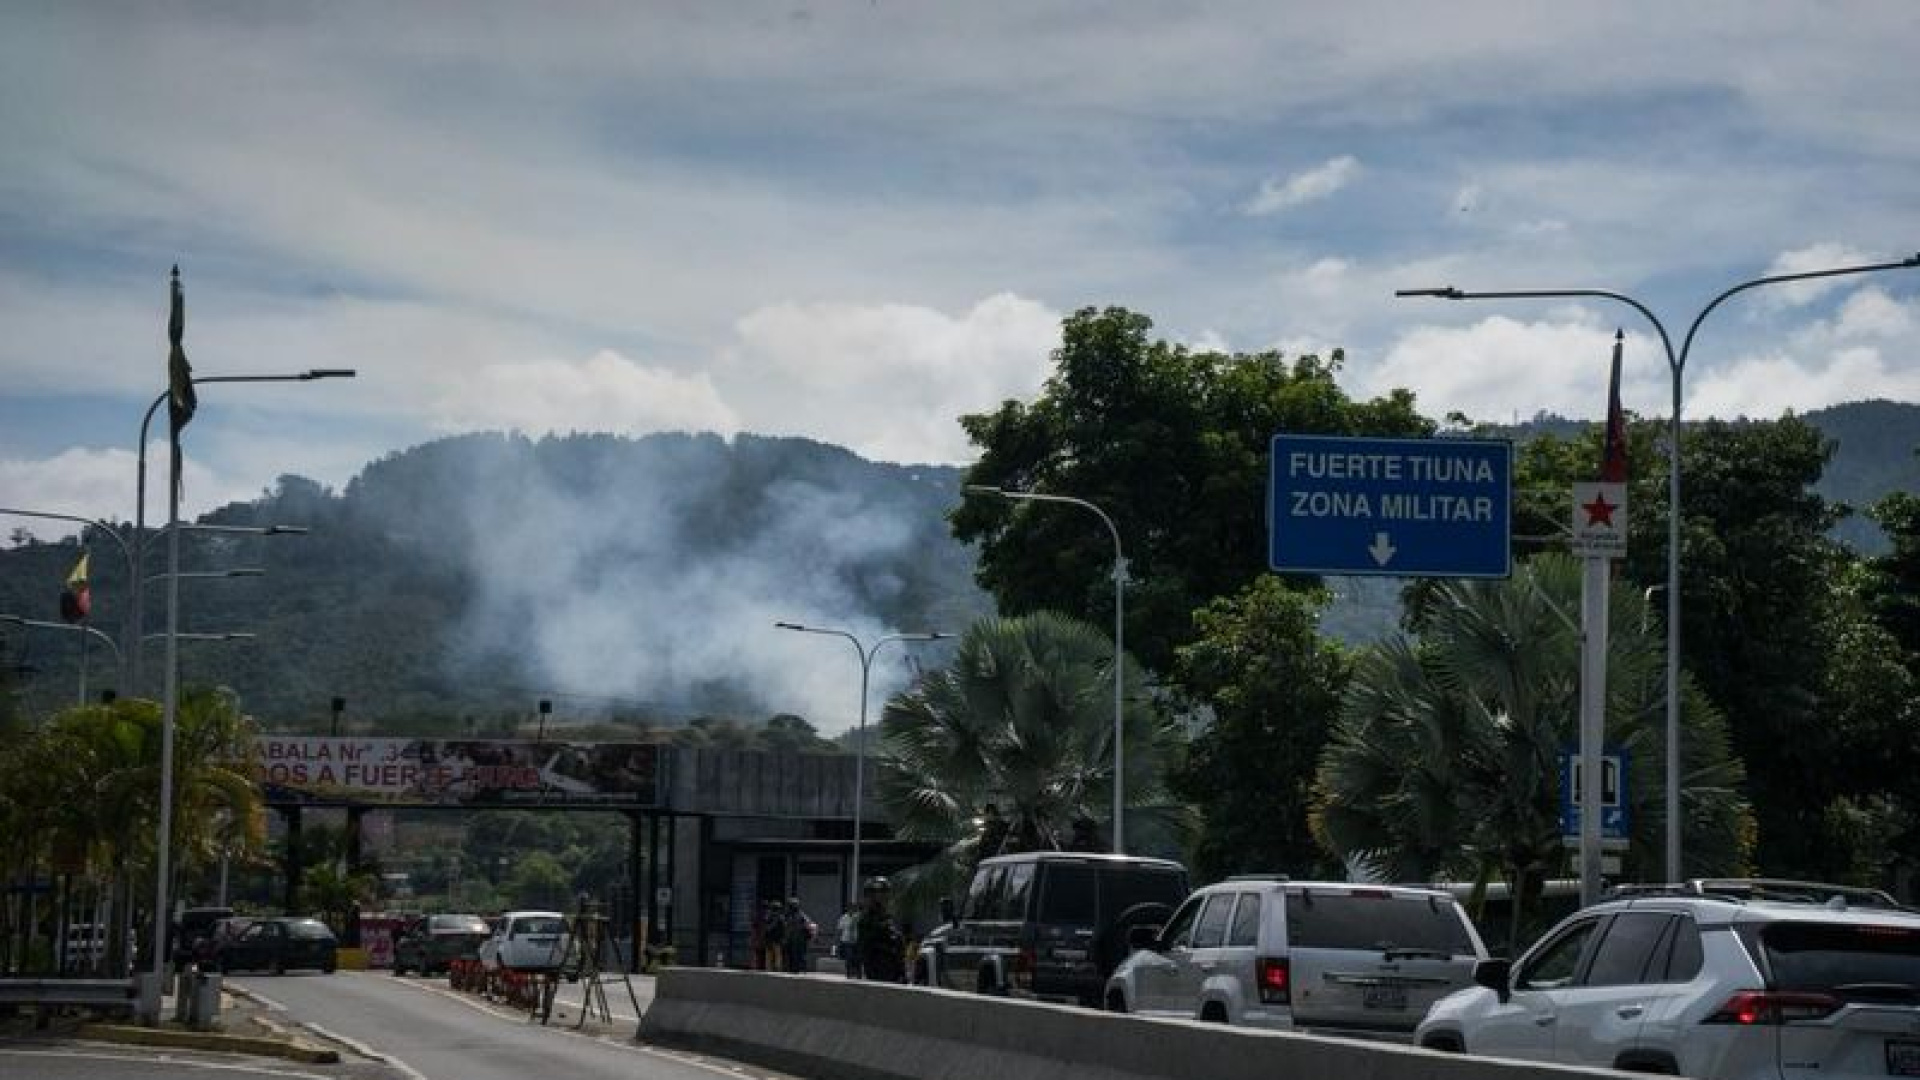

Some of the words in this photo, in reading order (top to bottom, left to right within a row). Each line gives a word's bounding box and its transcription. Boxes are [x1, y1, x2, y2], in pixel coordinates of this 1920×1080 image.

[1290, 453, 1402, 479] FUERTE
[1408, 457, 1494, 482] TIUNA
[1290, 492, 1371, 517] ZONA
[1381, 495, 1492, 521] MILITAR
[317, 765, 336, 785] A
